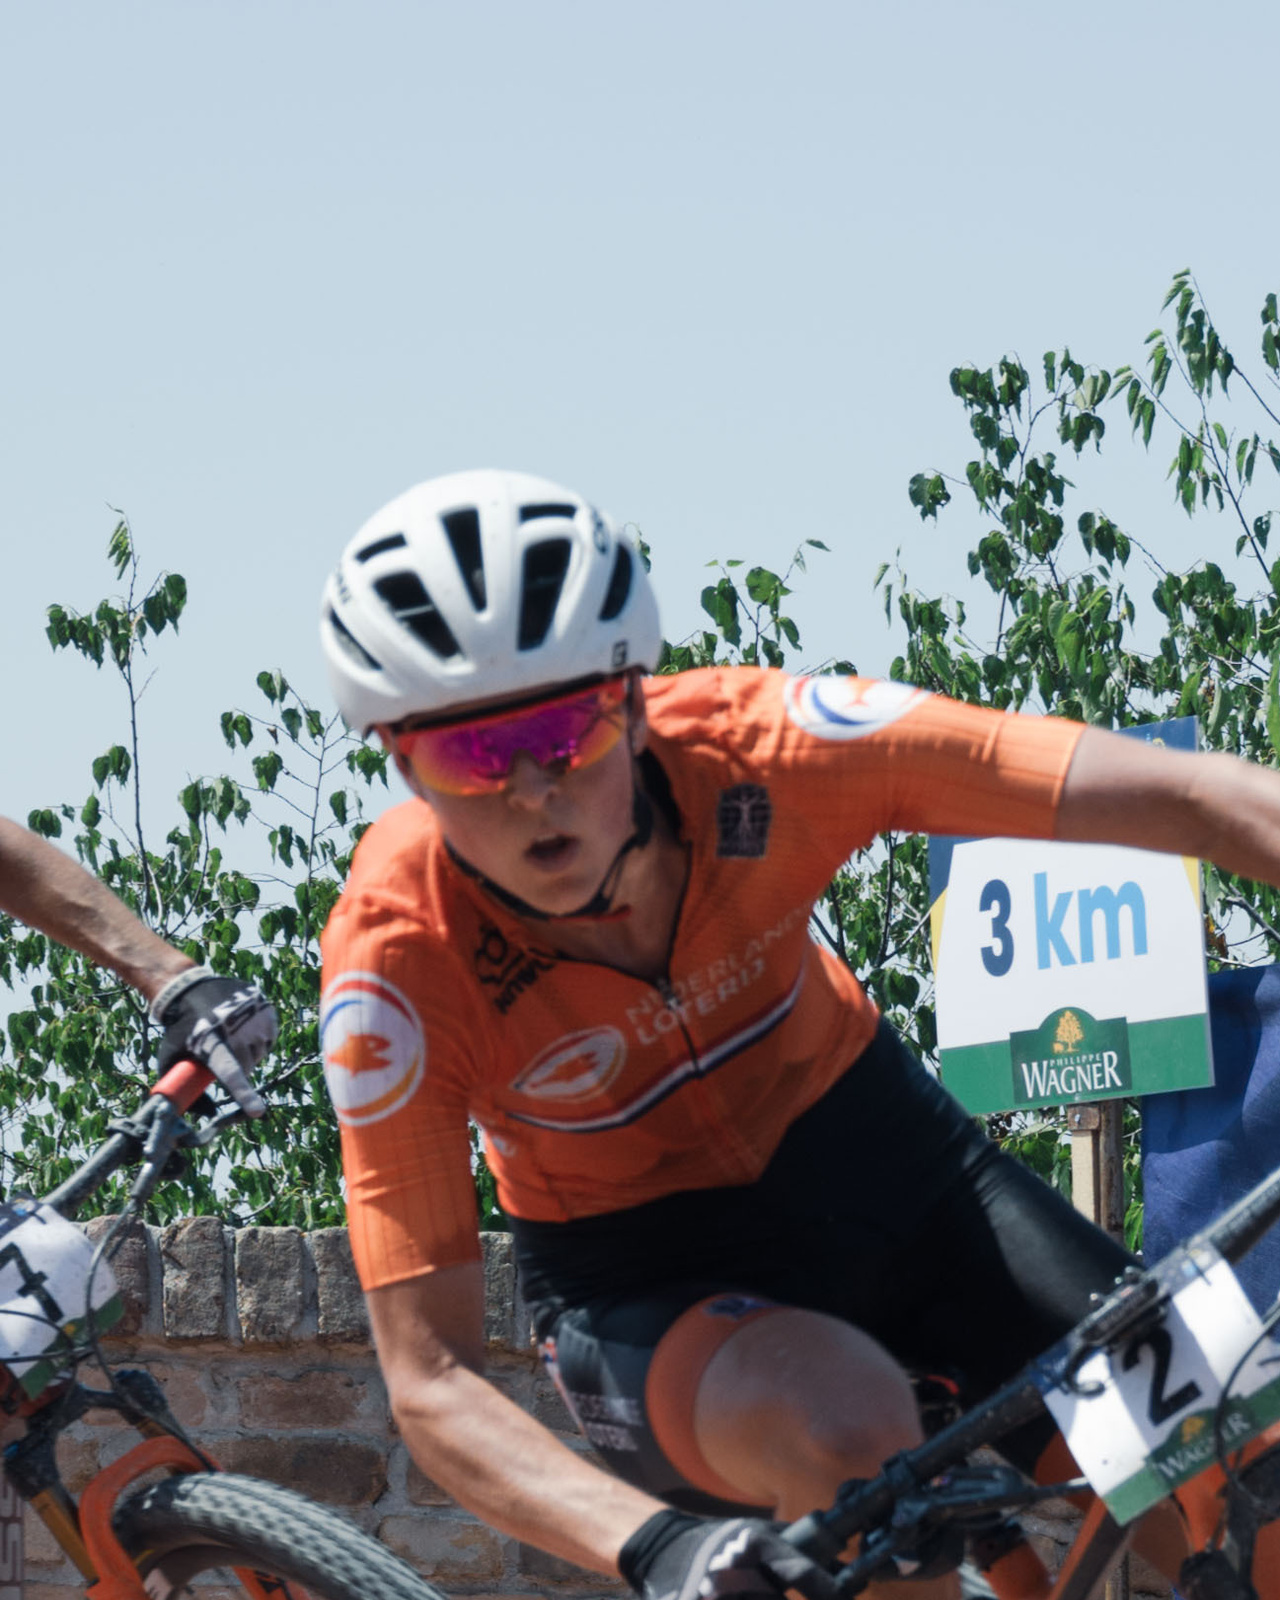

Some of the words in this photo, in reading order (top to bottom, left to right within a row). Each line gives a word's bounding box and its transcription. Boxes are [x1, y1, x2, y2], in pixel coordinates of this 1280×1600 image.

[980, 879, 1015, 976] 3
[1035, 874, 1148, 969] km
[1021, 1051, 1122, 1099] WAGNER
[1049, 1053, 1102, 1067] PHILIPPE
[1123, 1326, 1202, 1426] 2
